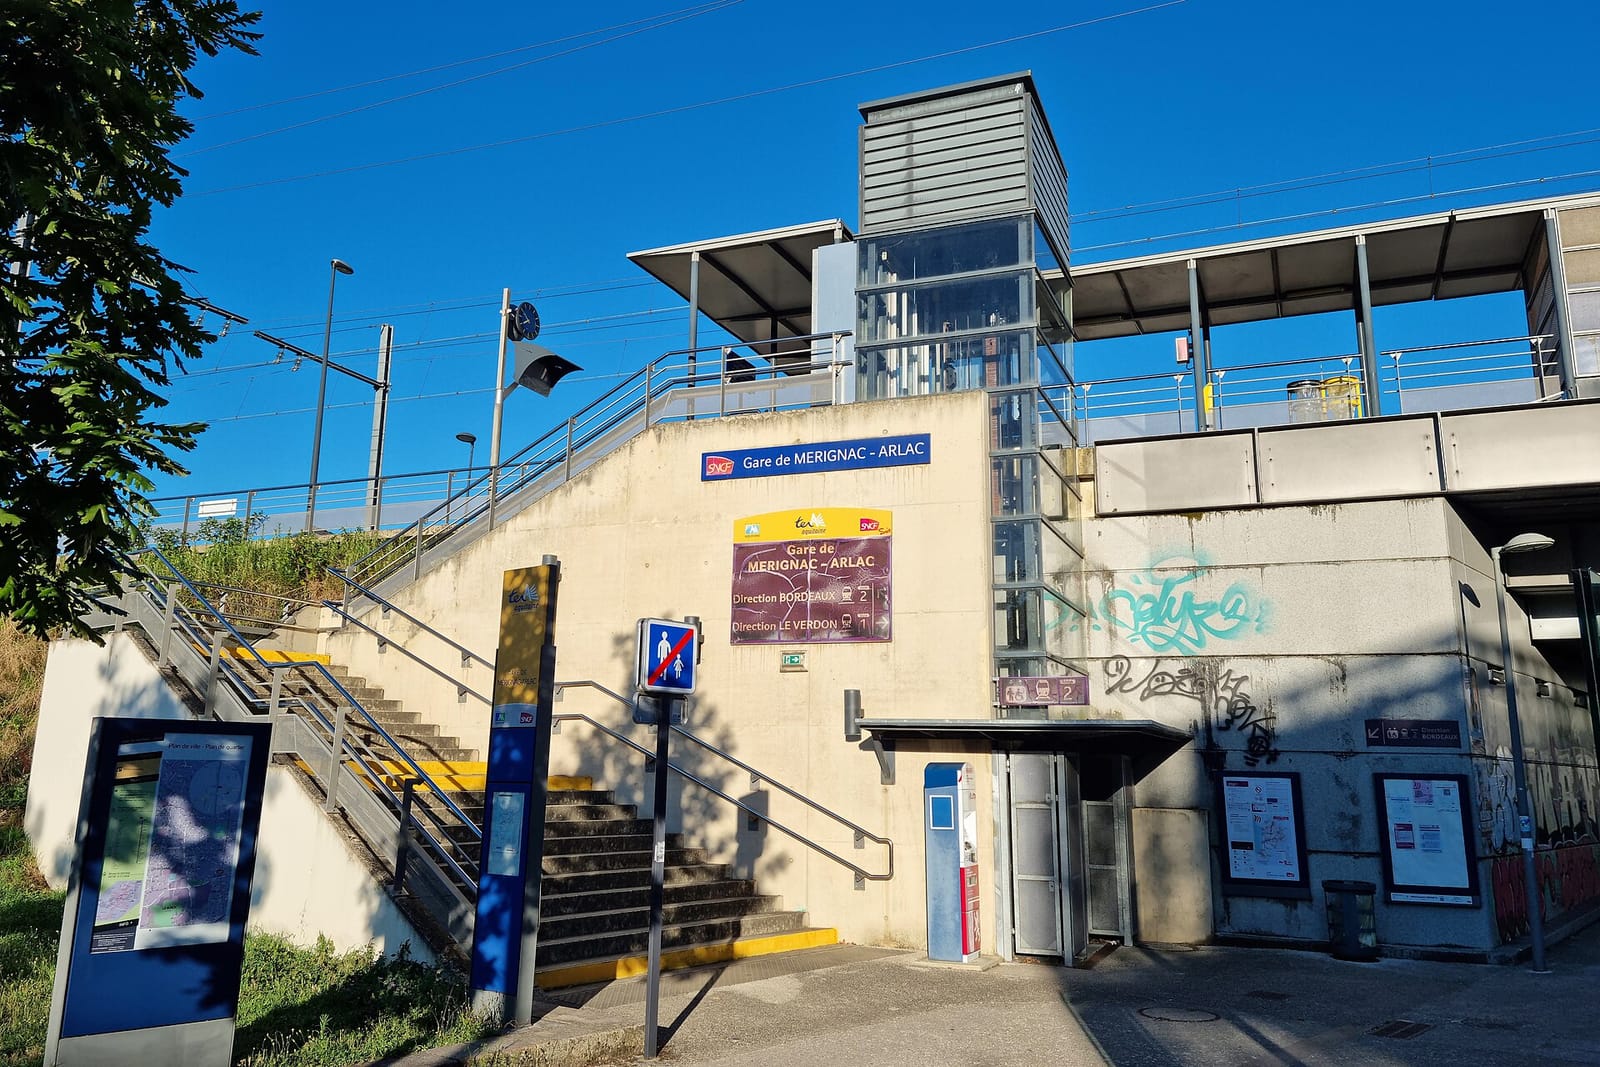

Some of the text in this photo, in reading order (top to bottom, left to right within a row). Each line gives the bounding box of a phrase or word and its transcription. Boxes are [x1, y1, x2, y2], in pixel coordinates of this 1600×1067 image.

[743, 457, 772, 469] Gare
[775, 454, 791, 466] de
[794, 447, 867, 465] MERIGNAC
[878, 442, 925, 458] ARLAC
[707, 462, 733, 474] SNCF
[861, 522, 879, 531] SNCF
[787, 543, 835, 556] Gare de
[747, 558, 818, 573] MERIGNAC
[830, 555, 875, 569] ARLAC
[733, 591, 836, 604] Direction BORDEAUX
[860, 591, 868, 602] 2
[732, 619, 838, 632] Direction LE VERDON
[860, 619, 867, 629] 1
[1063, 686, 1073, 701] 2
